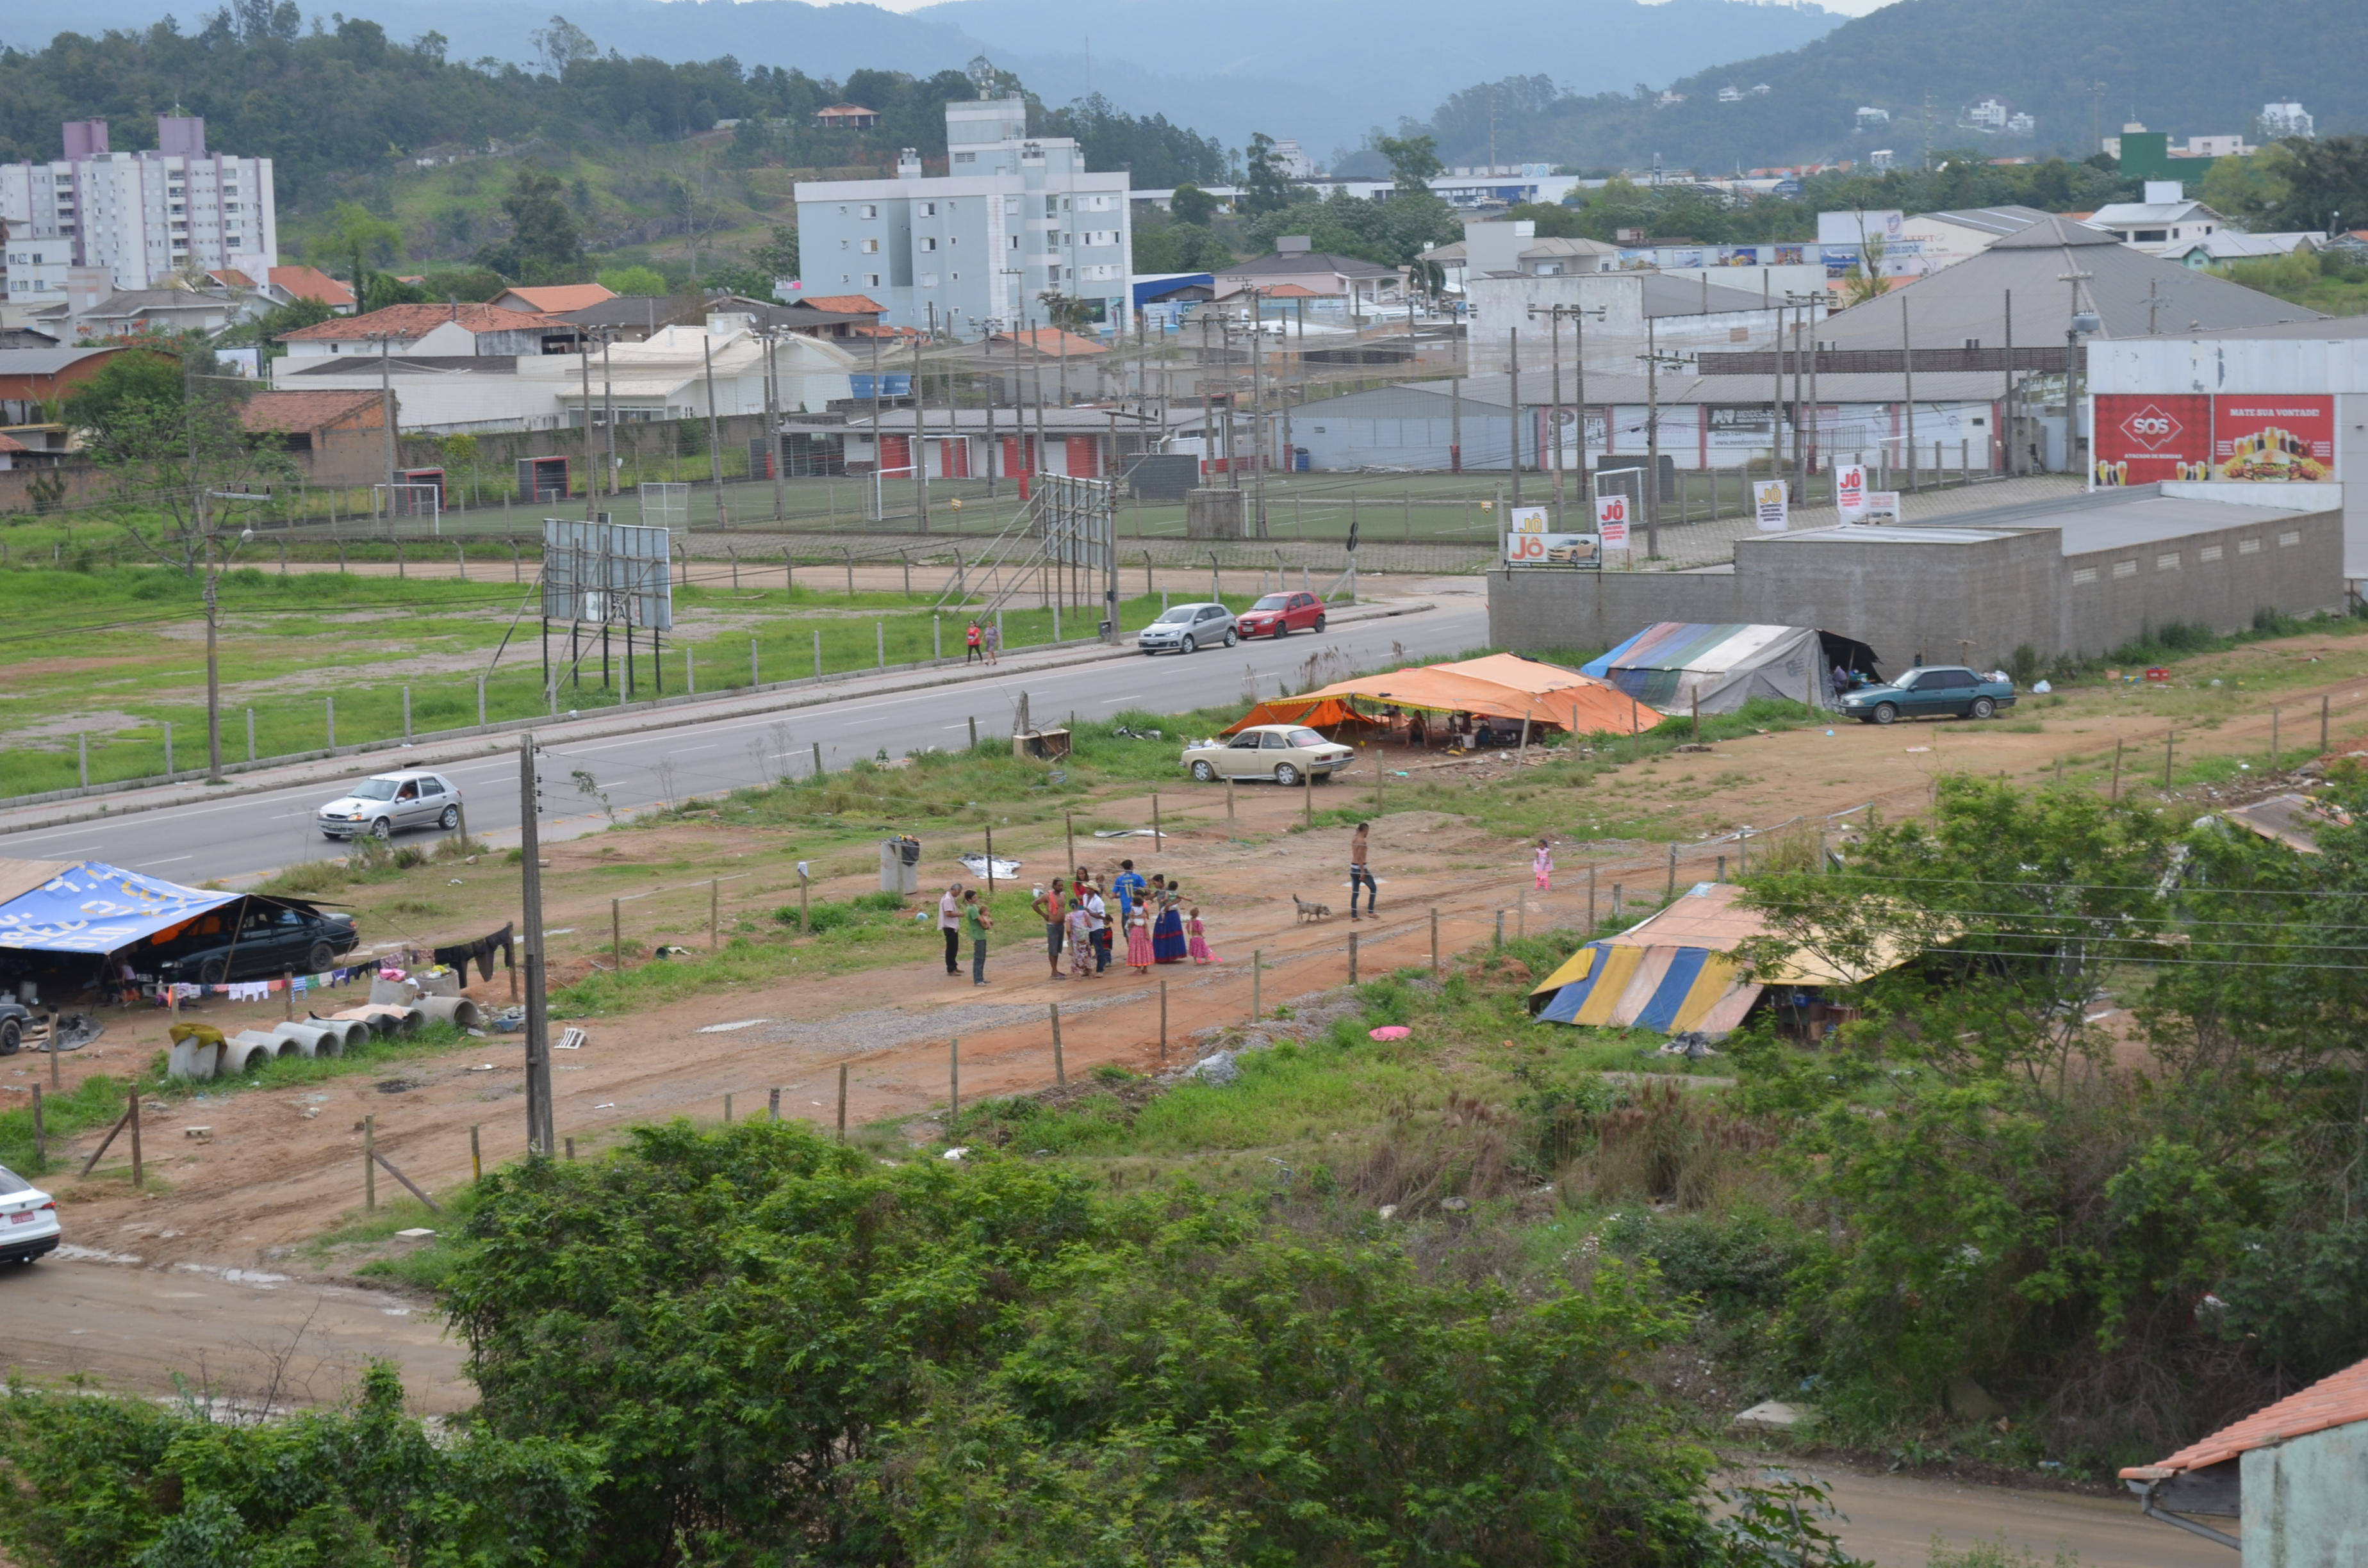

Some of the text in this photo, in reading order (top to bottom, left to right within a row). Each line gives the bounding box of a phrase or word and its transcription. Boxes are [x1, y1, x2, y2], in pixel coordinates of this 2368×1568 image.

[2229, 409, 2255, 417] MATE
[2256, 409, 2275, 417] SUA
[2133, 418, 2170, 435] SOS
[1839, 468, 1861, 489] JÔ
[1759, 484, 1782, 503] JÔ
[1601, 500, 1624, 521] JÔ
[1518, 512, 1542, 533] JÔ
[1124, 883, 1133, 898] 11
